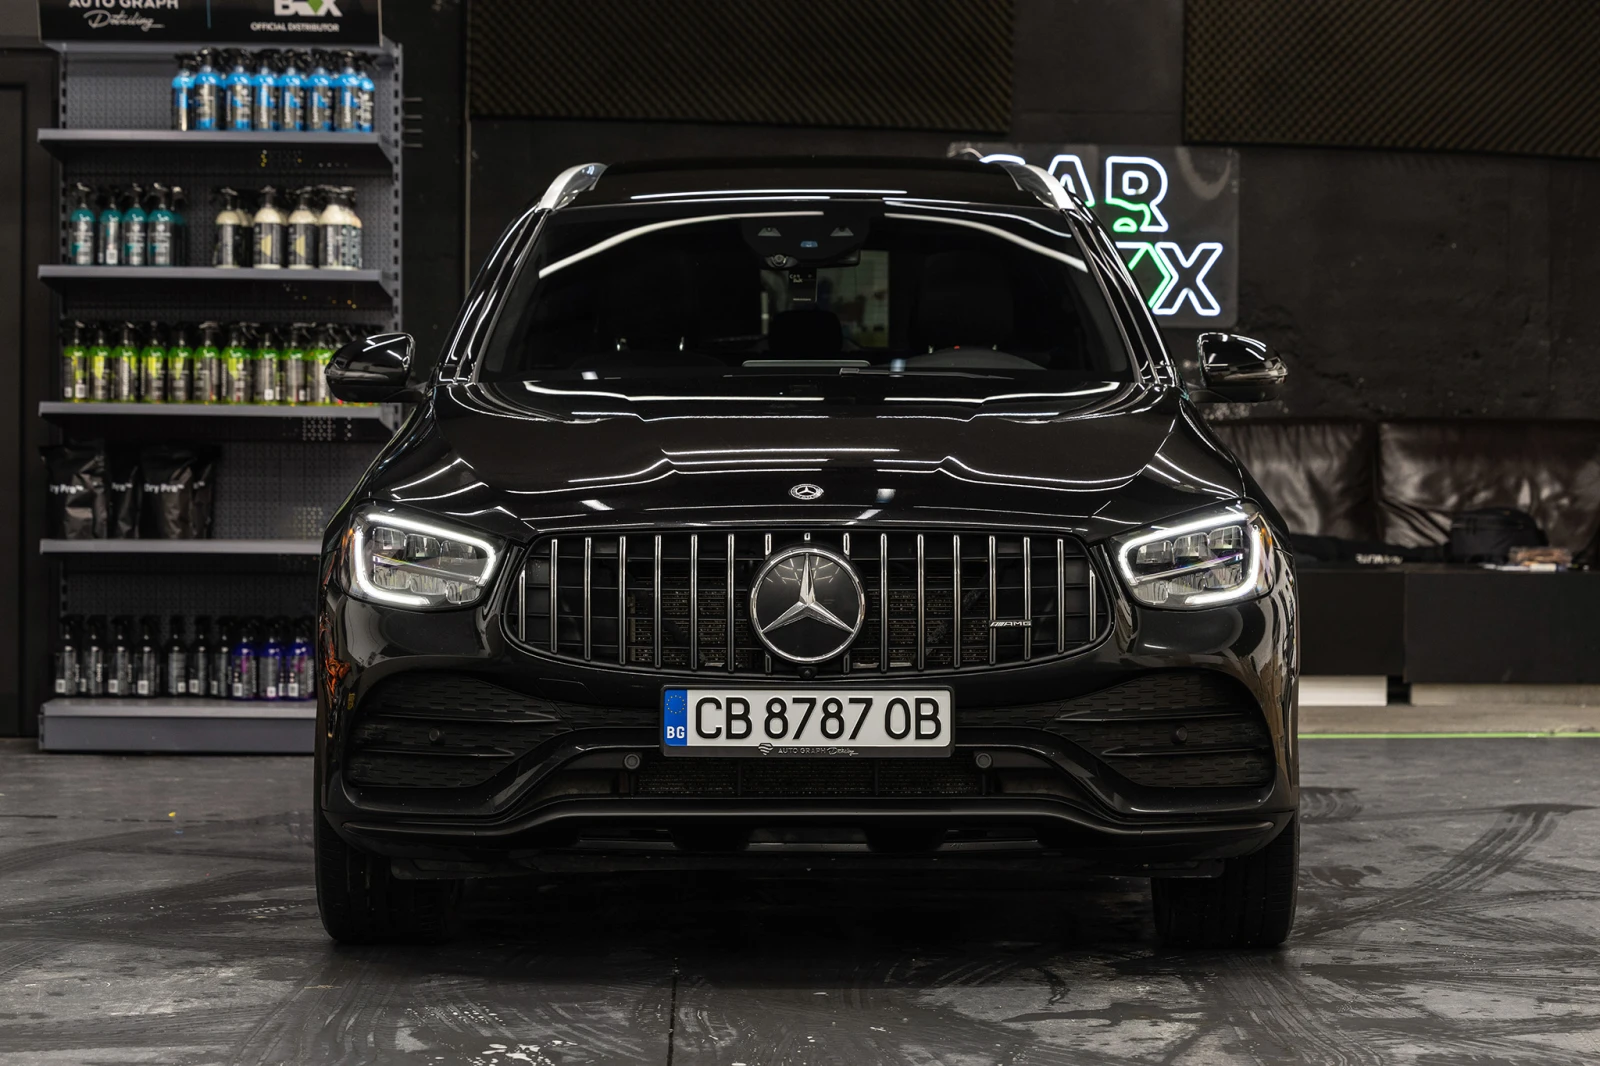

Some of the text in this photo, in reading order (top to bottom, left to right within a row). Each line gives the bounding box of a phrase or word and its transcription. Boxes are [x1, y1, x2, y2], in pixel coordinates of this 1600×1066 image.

[250, 21, 339, 32] OFFICIAL DISTRIBUTOR
[980, 153, 1169, 233] AR
[666, 726, 685, 739] BG
[695, 697, 753, 740] CB
[764, 697, 873, 740] 8787
